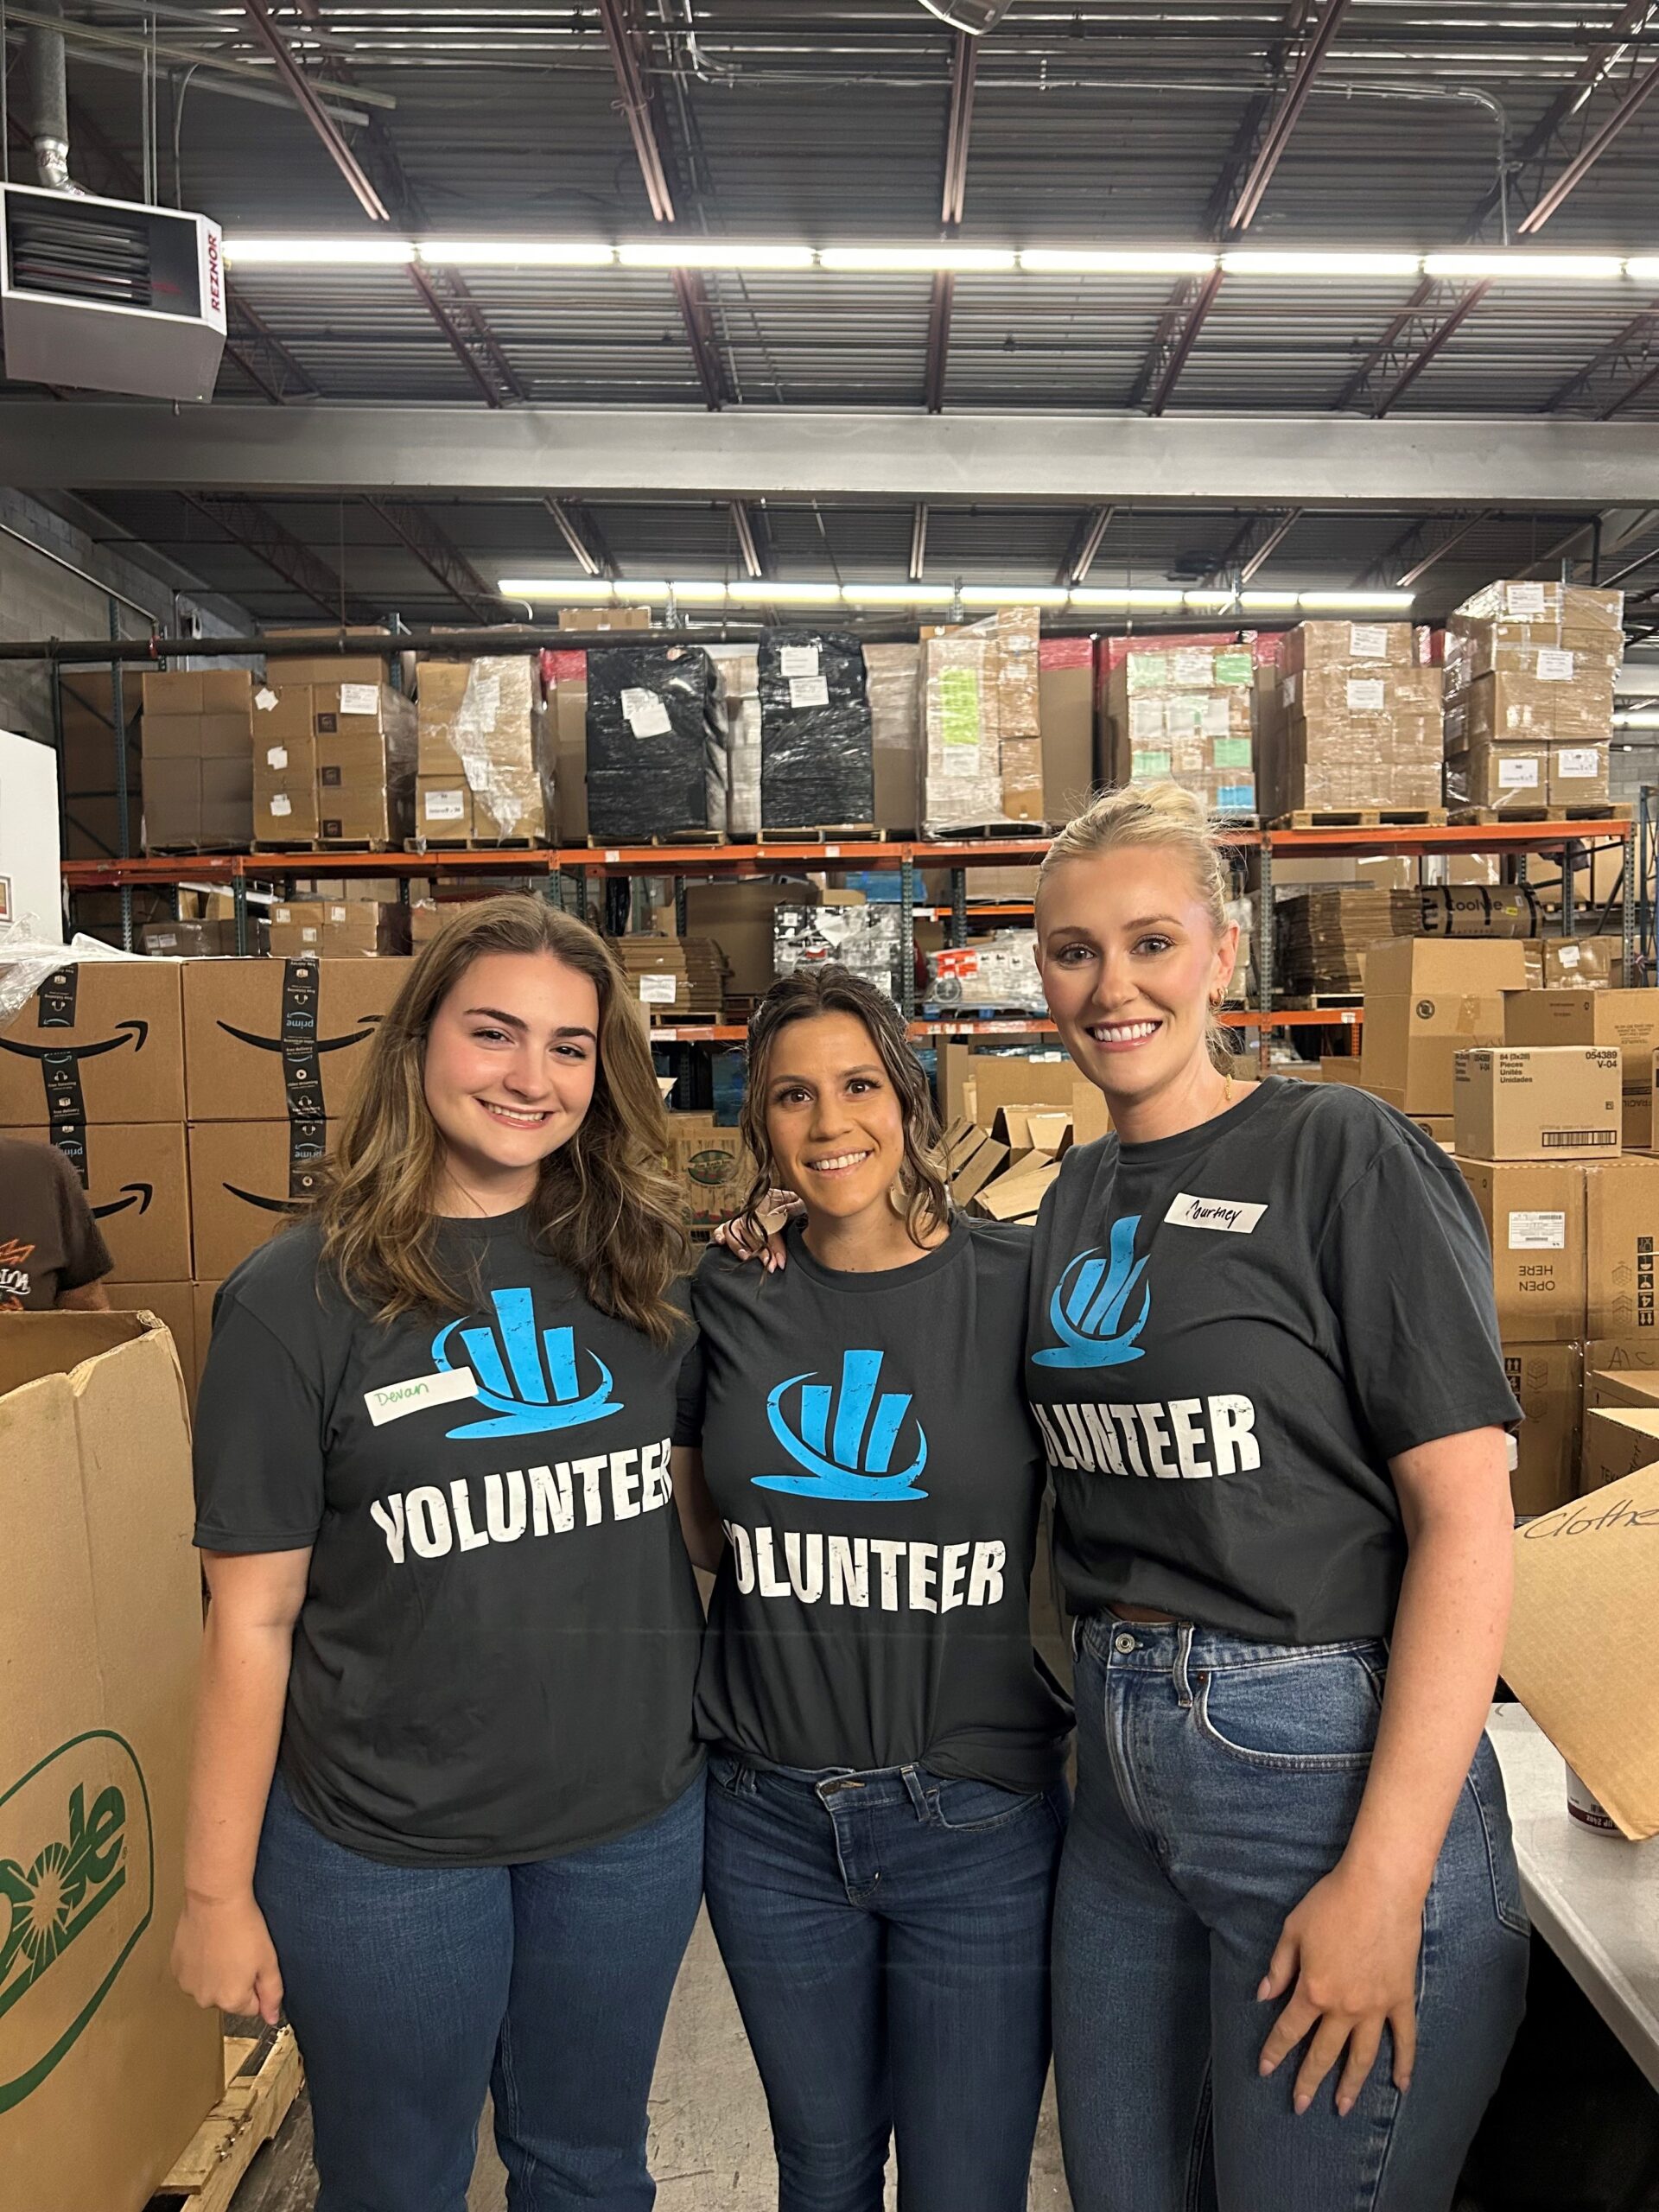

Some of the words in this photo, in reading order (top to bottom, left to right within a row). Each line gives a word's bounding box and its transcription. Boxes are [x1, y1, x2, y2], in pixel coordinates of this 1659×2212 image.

[207, 232, 220, 311] REZNOR
[286, 1019, 315, 1029] prime
[1518, 1265, 1553, 1276] HERE
[1519, 1281, 1555, 1292] OPEN
[374, 1382, 429, 1406] Devan
